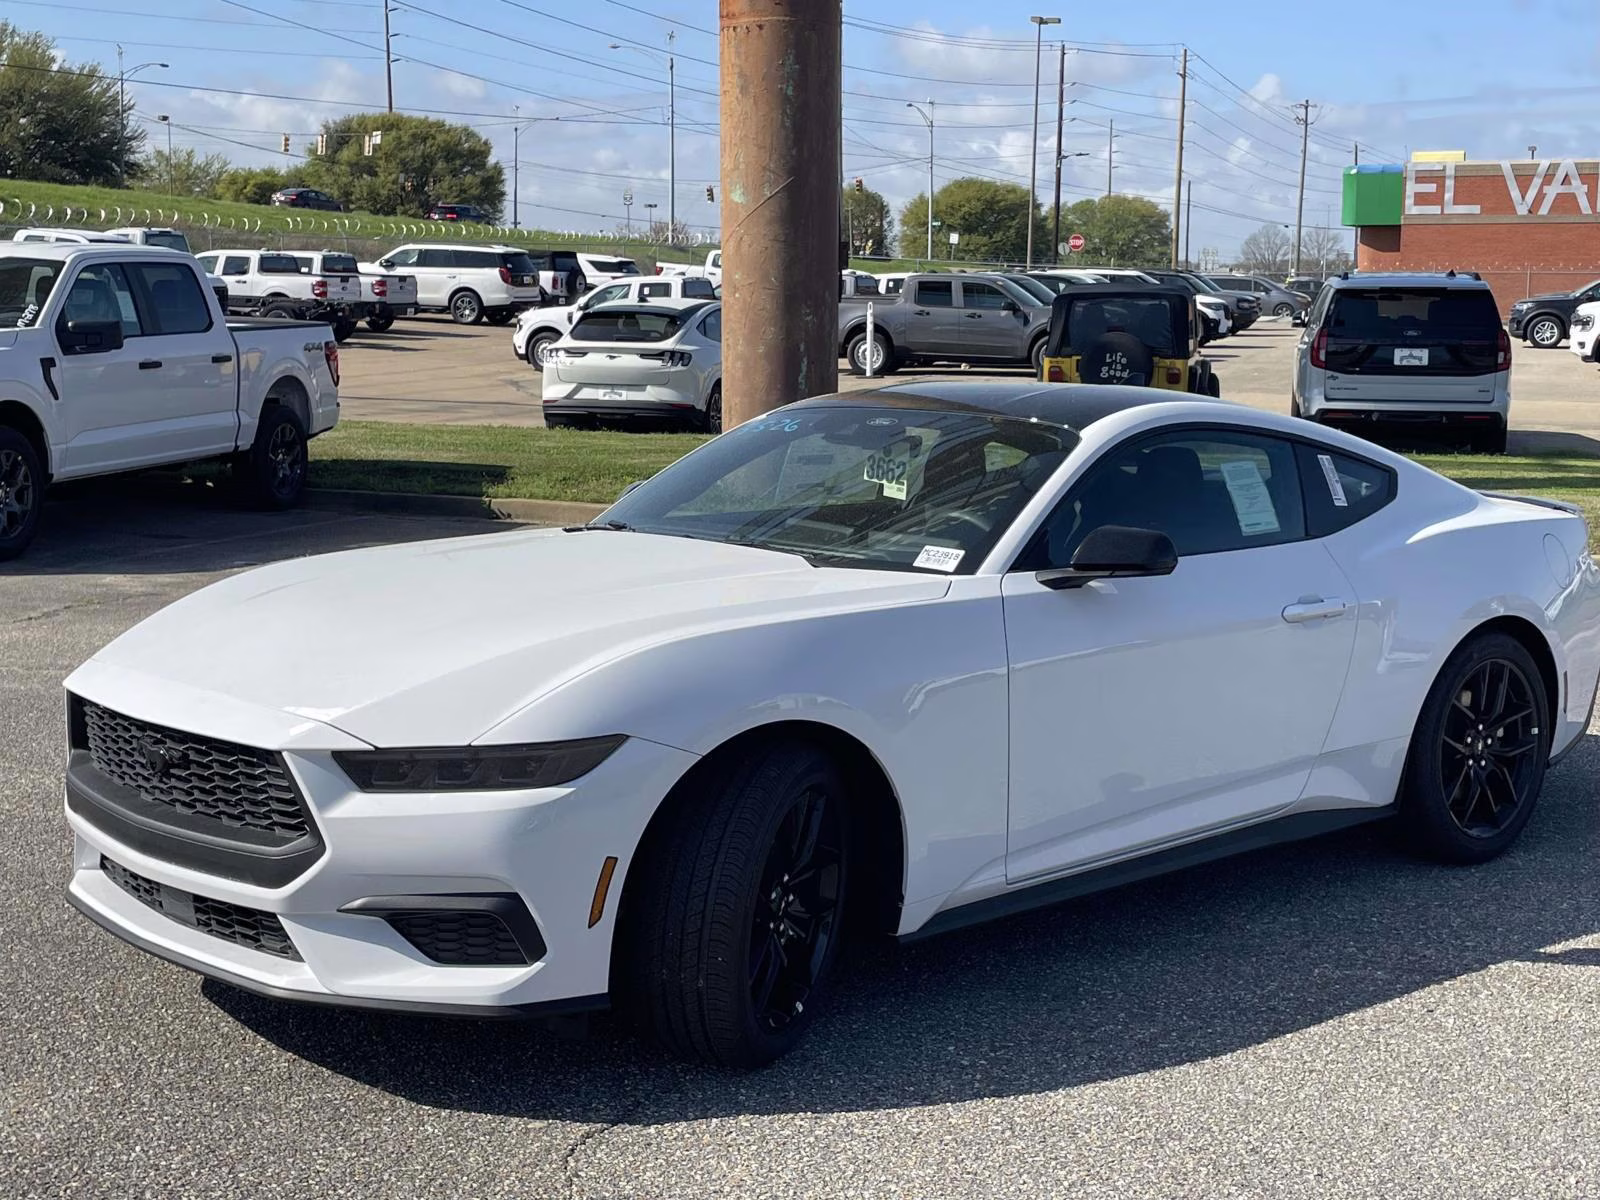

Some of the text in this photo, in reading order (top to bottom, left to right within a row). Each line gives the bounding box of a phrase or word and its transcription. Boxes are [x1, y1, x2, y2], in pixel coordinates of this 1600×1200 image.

[1405, 159, 1600, 215] EL VA
[866, 454, 906, 487] 3662
[921, 548, 961, 561] MC23918
